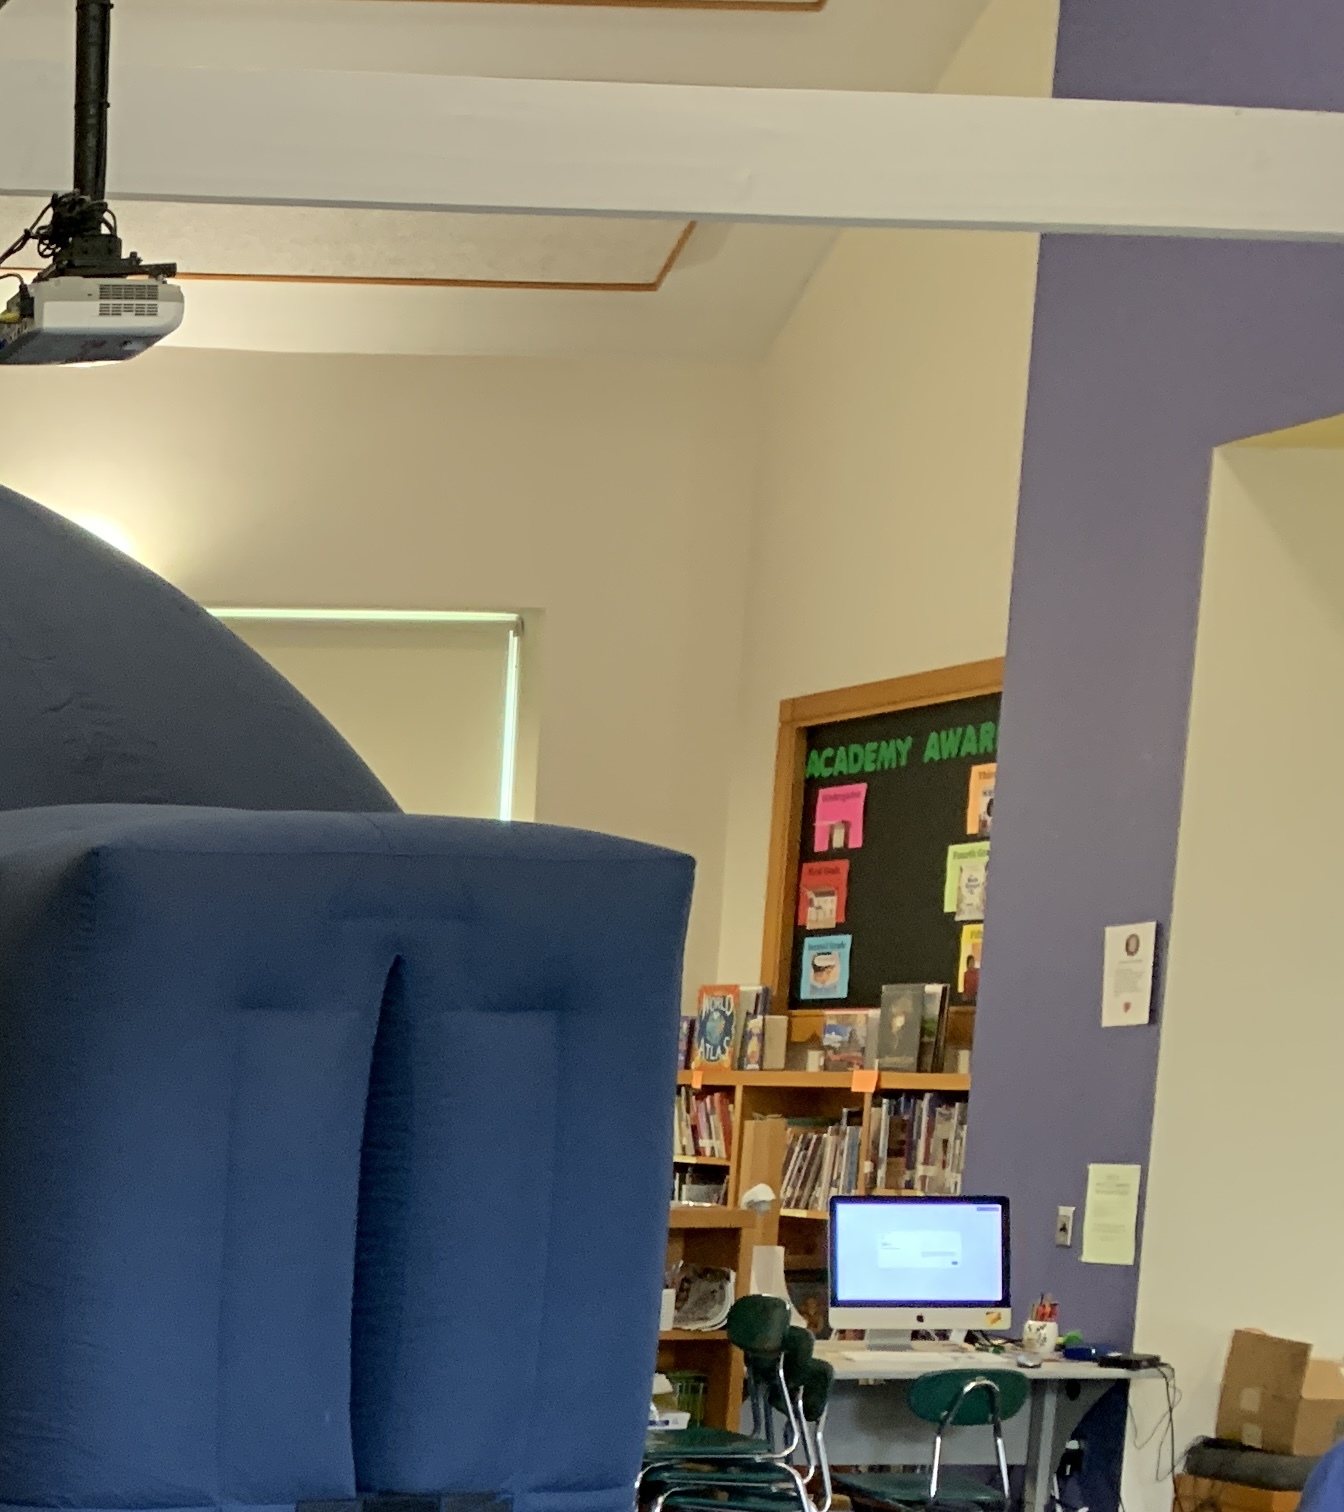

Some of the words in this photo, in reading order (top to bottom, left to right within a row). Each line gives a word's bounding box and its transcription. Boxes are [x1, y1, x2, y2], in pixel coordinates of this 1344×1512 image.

[806, 736, 912, 778] ACADEMY
[923, 721, 998, 763] AWAR
[699, 1036, 731, 1060] ATLAS
